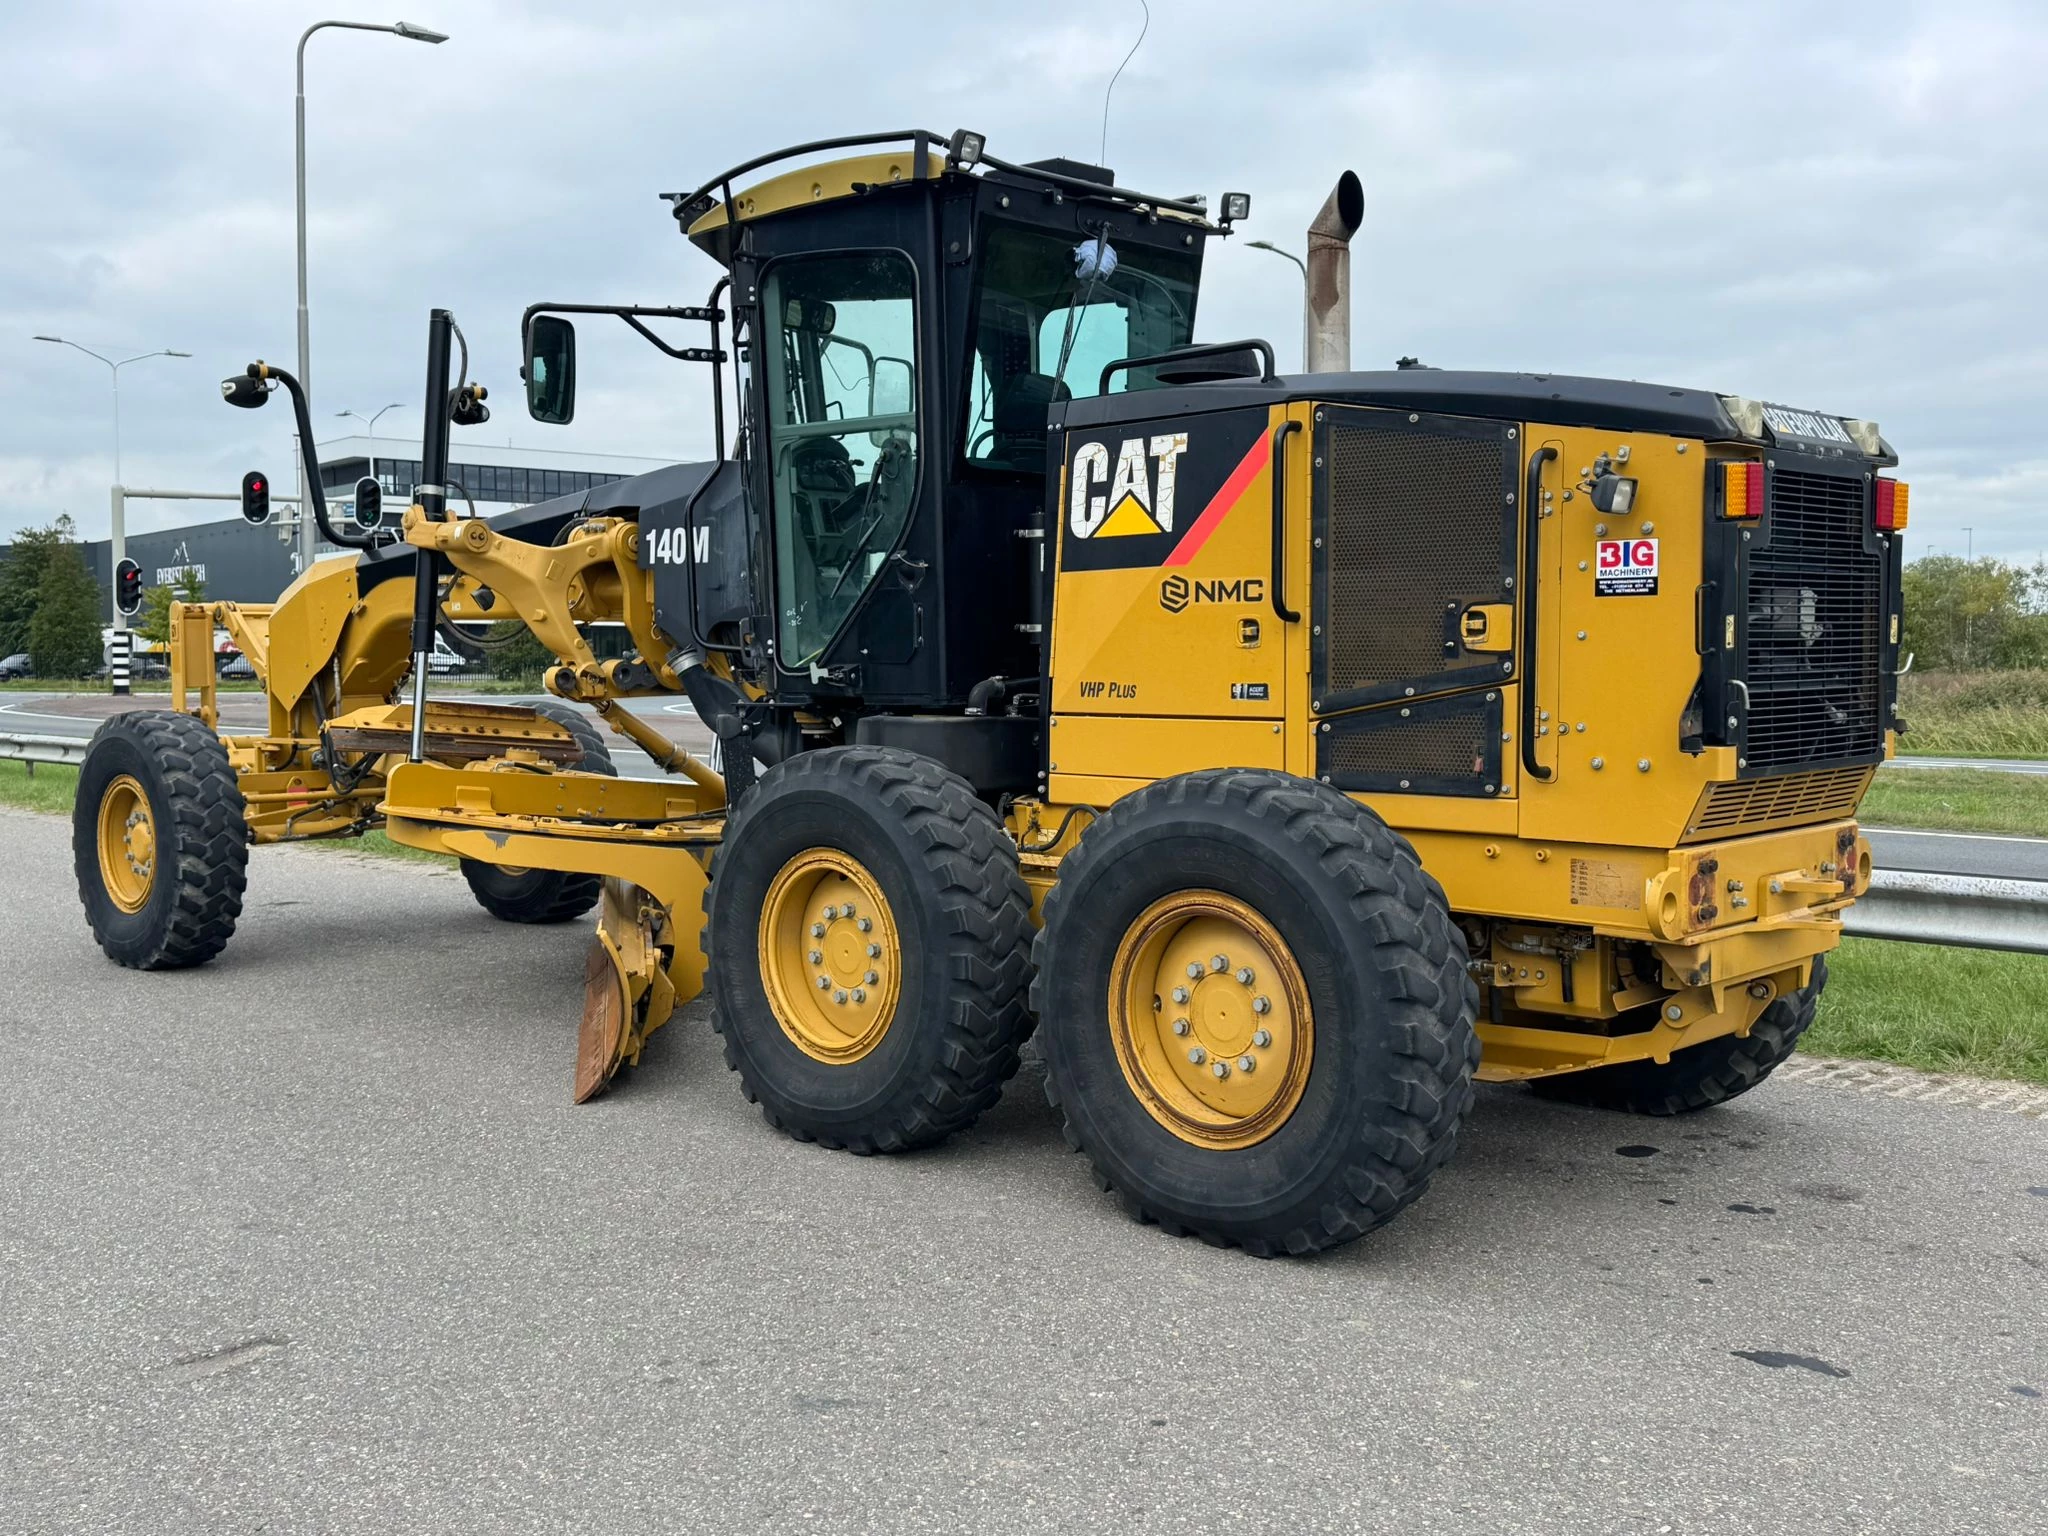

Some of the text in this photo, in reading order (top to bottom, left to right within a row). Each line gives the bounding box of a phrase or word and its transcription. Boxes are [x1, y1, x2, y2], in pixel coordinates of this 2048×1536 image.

[1761, 408, 1852, 443] CATERPILLAR
[1070, 432, 1189, 539] CAT
[1601, 541, 1653, 568] BIG
[1600, 568, 1653, 576] MACHINERY
[1194, 579, 1264, 603] NMC
[1080, 681, 1105, 698] VHP
